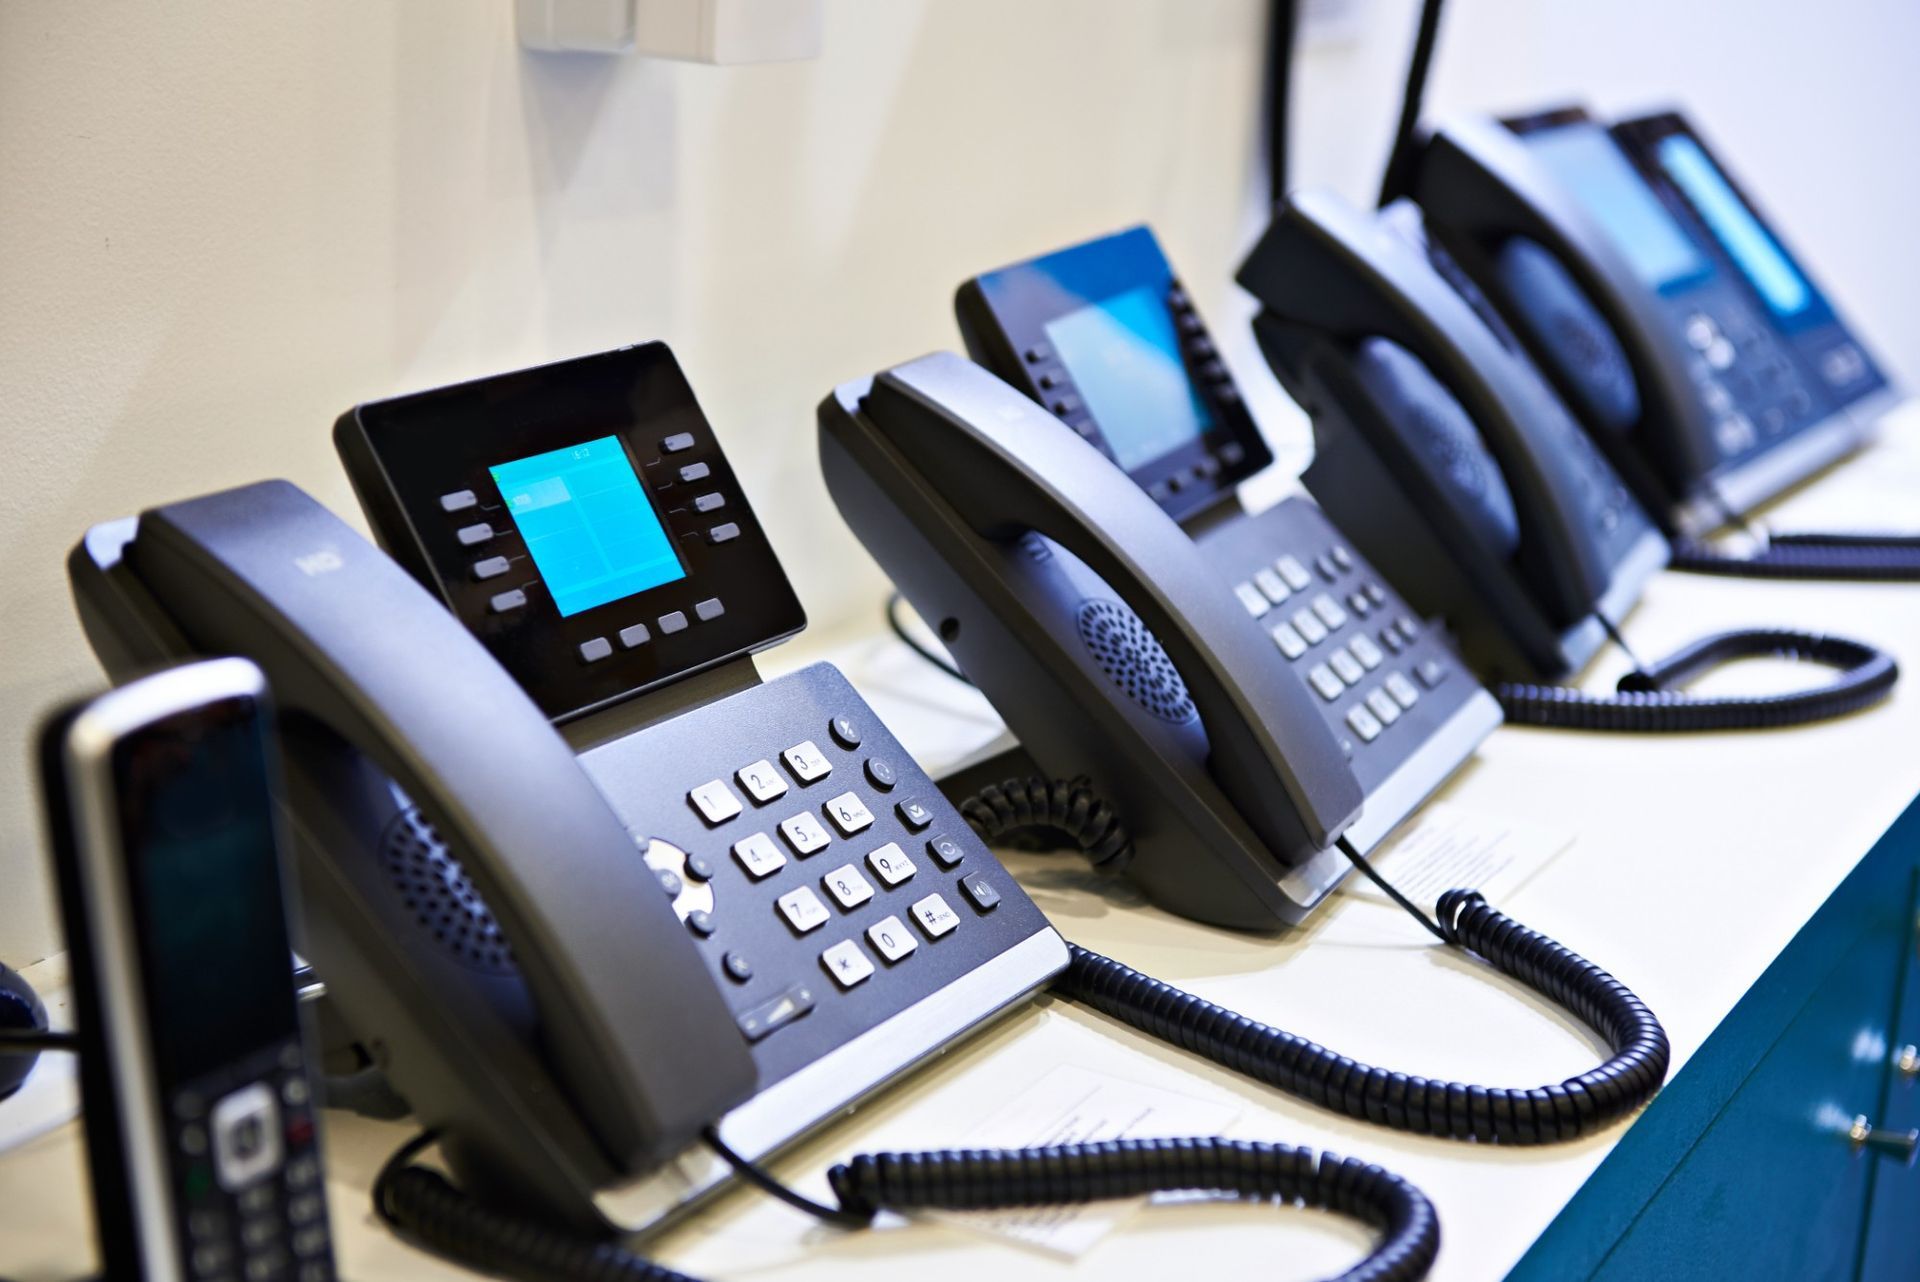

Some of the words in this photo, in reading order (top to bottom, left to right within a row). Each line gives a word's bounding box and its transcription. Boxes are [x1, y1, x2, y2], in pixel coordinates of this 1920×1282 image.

[794, 754, 809, 771] 3
[751, 774, 766, 790] 2
[703, 795, 717, 811] 1
[839, 807, 852, 823] 6
[794, 826, 808, 842] 5
[750, 848, 763, 863] 4
[879, 857, 893, 874] 9
[837, 880, 851, 896] 8
[790, 903, 803, 919] 7
[881, 932, 896, 949] 0
